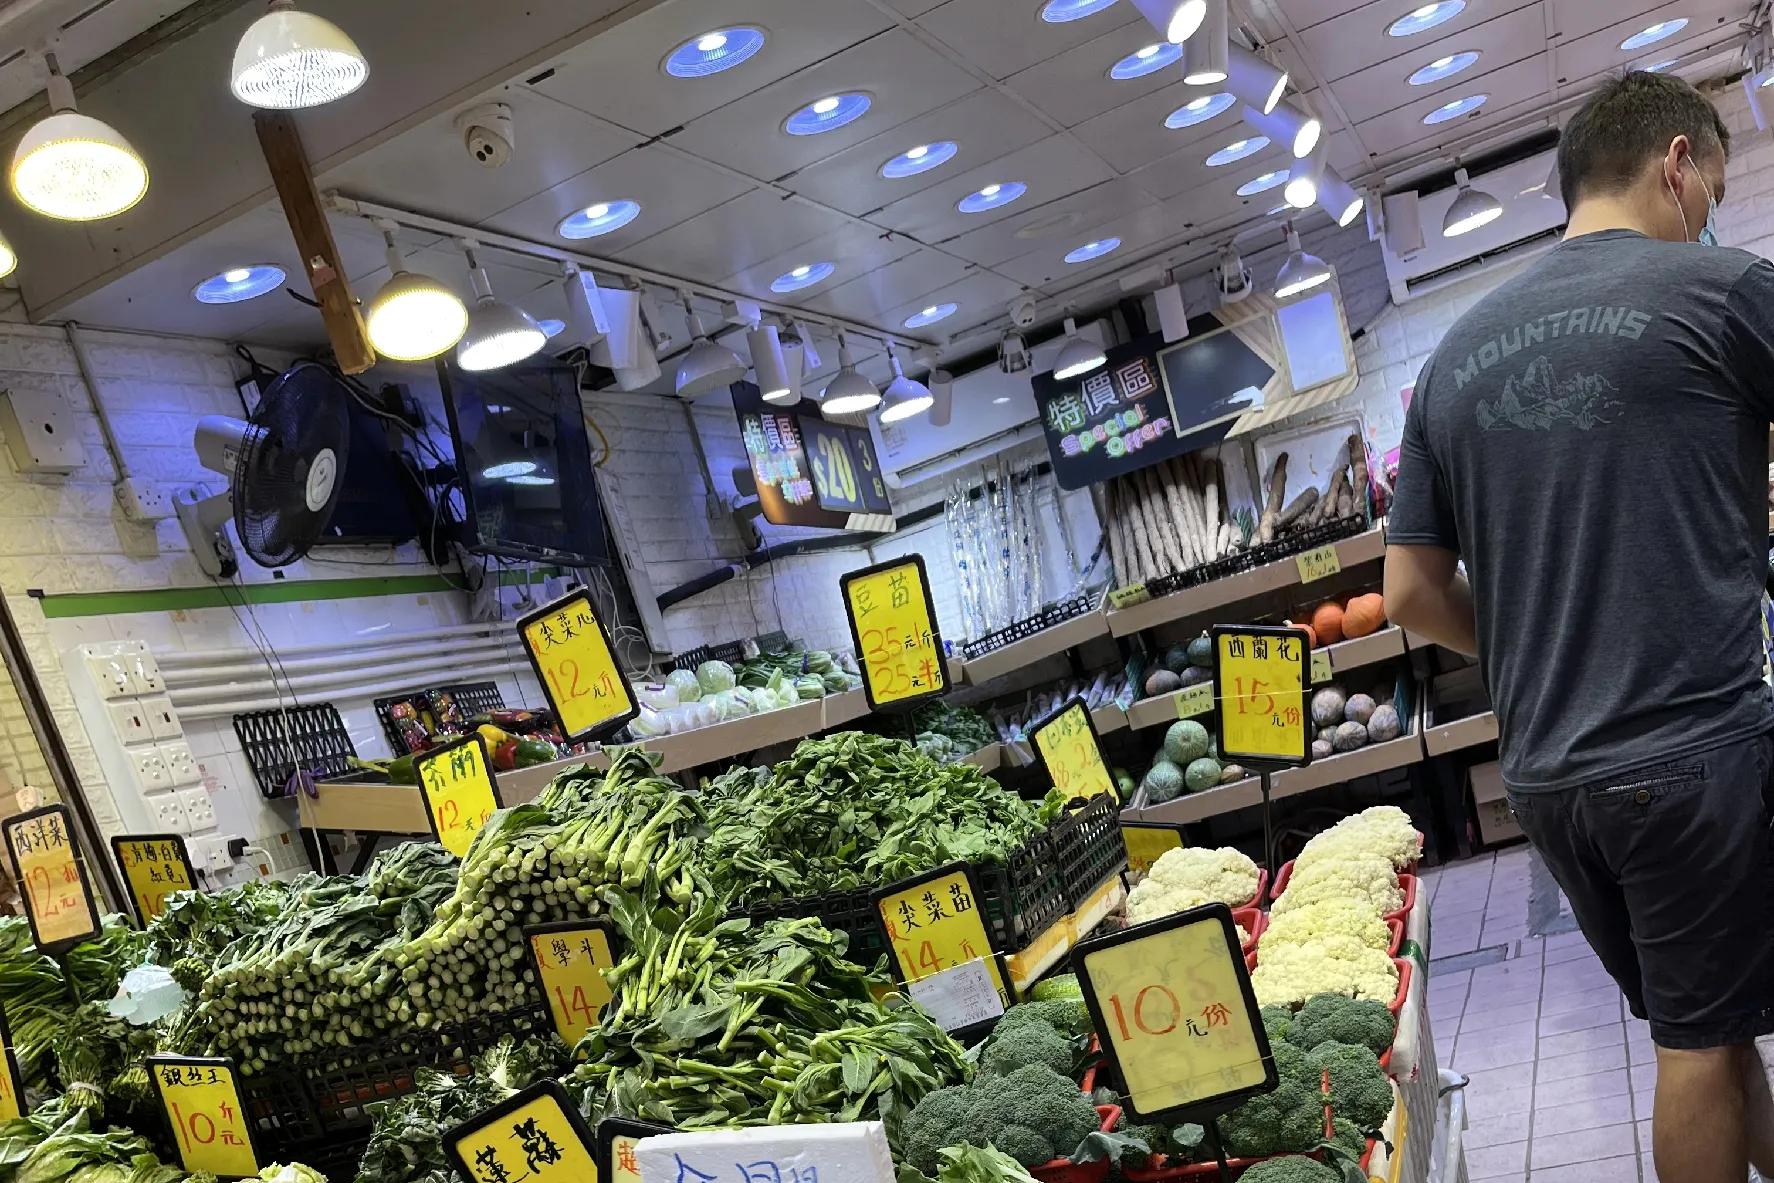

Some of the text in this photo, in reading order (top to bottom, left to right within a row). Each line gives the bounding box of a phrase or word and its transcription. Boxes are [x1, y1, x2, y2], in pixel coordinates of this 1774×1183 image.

[1453, 306, 1652, 391] MOUNTAINS
[1048, 359, 1153, 432] 特價區
[1060, 404, 1146, 457] Special
[1105, 417, 1171, 457] Offer
[856, 572, 910, 618] 豆苗
[1229, 635, 1300, 661] 西蘭花
[14, 816, 69, 857] 西洋菜
[899, 883, 972, 933] 尖菜苗
[555, 985, 598, 1026] 14
